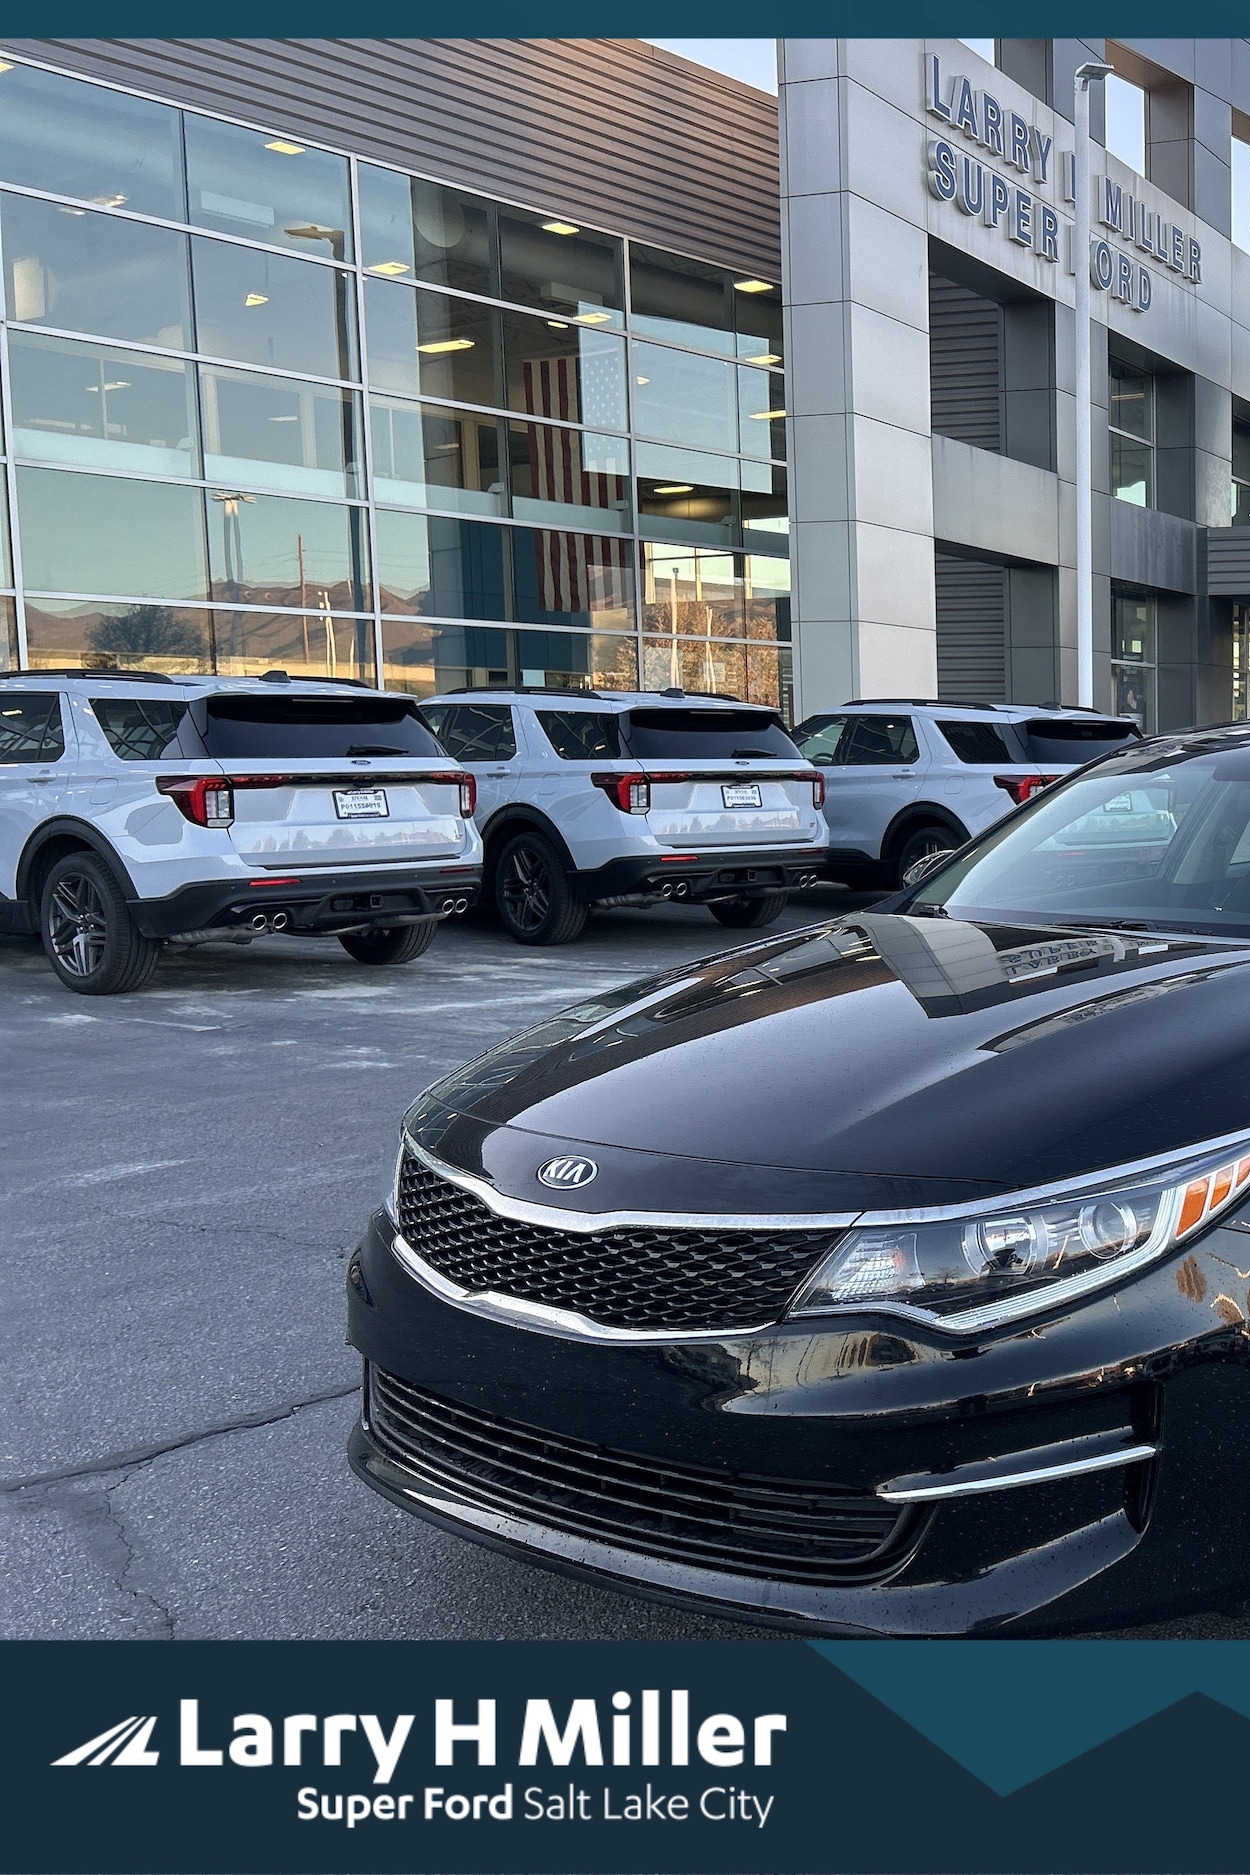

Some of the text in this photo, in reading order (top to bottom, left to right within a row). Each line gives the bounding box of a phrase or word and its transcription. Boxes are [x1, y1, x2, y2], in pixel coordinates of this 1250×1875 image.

[926, 52, 1053, 184] LARRY
[1099, 175, 1202, 284] MILLER
[928, 140, 1059, 263] SUPER
[1070, 226, 1153, 313] ORD
[542, 1159, 587, 1184] KIA
